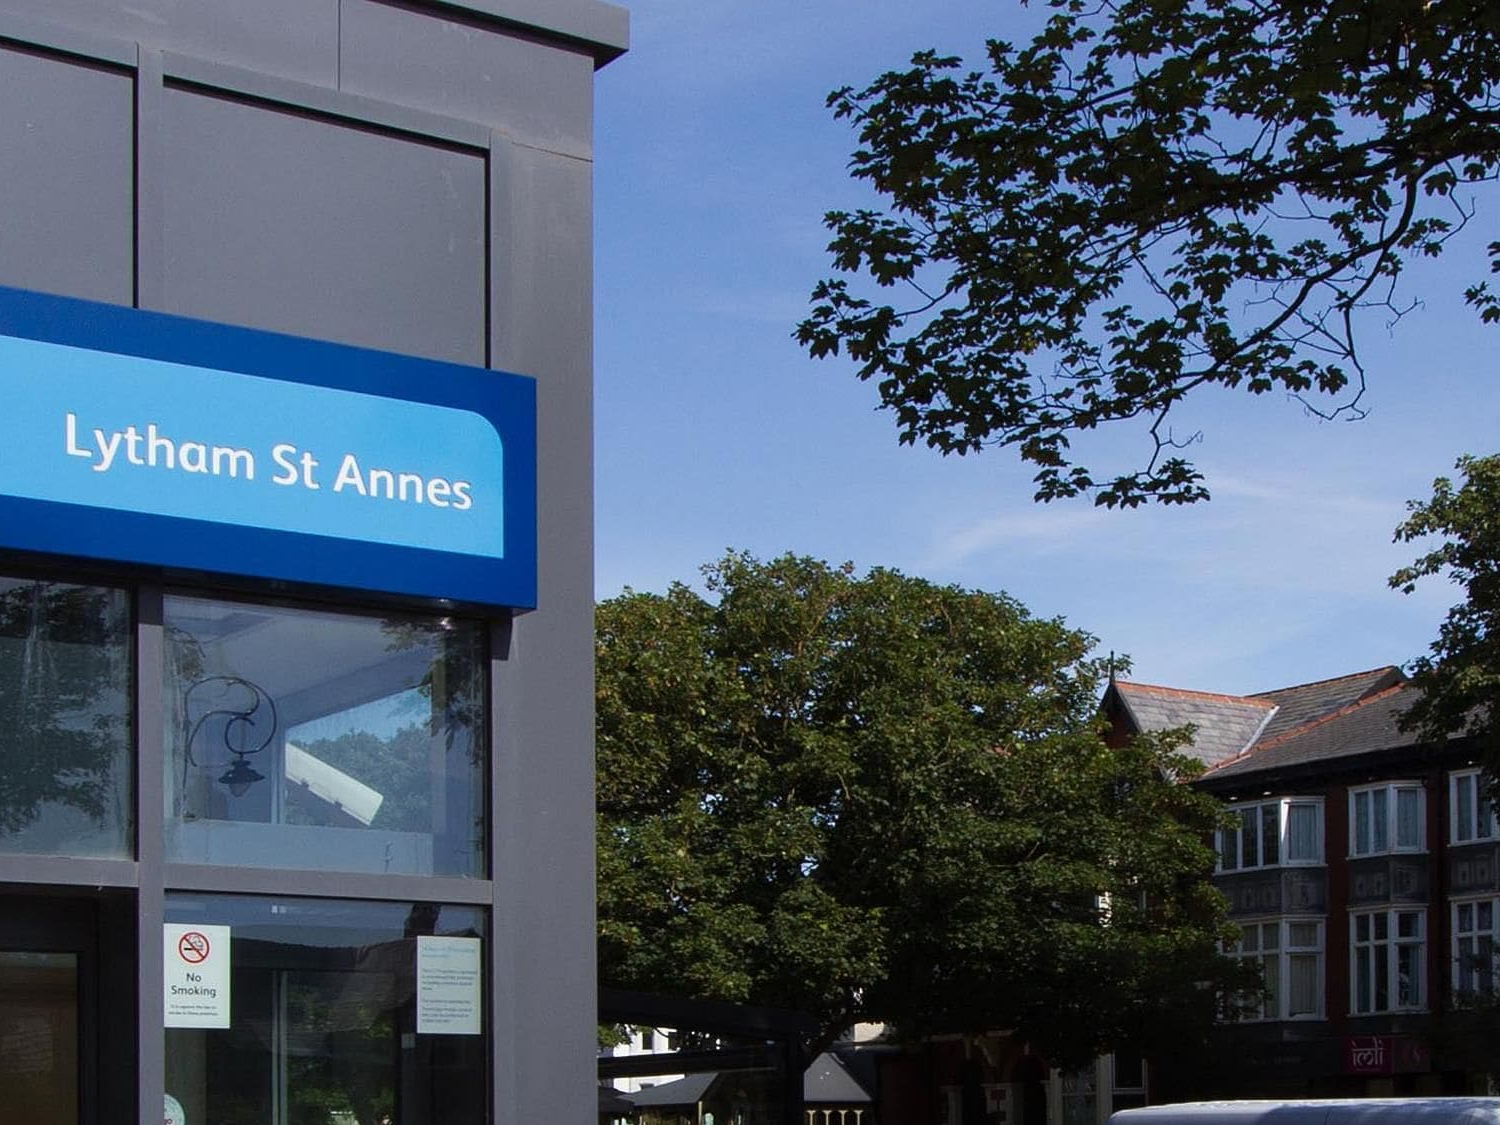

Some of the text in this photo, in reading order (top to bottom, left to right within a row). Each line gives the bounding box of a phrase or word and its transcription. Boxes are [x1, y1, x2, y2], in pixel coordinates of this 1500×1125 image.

[65, 413, 473, 510] Lytham St Annes
[186, 973, 202, 982] No
[171, 985, 217, 998] Smoking
